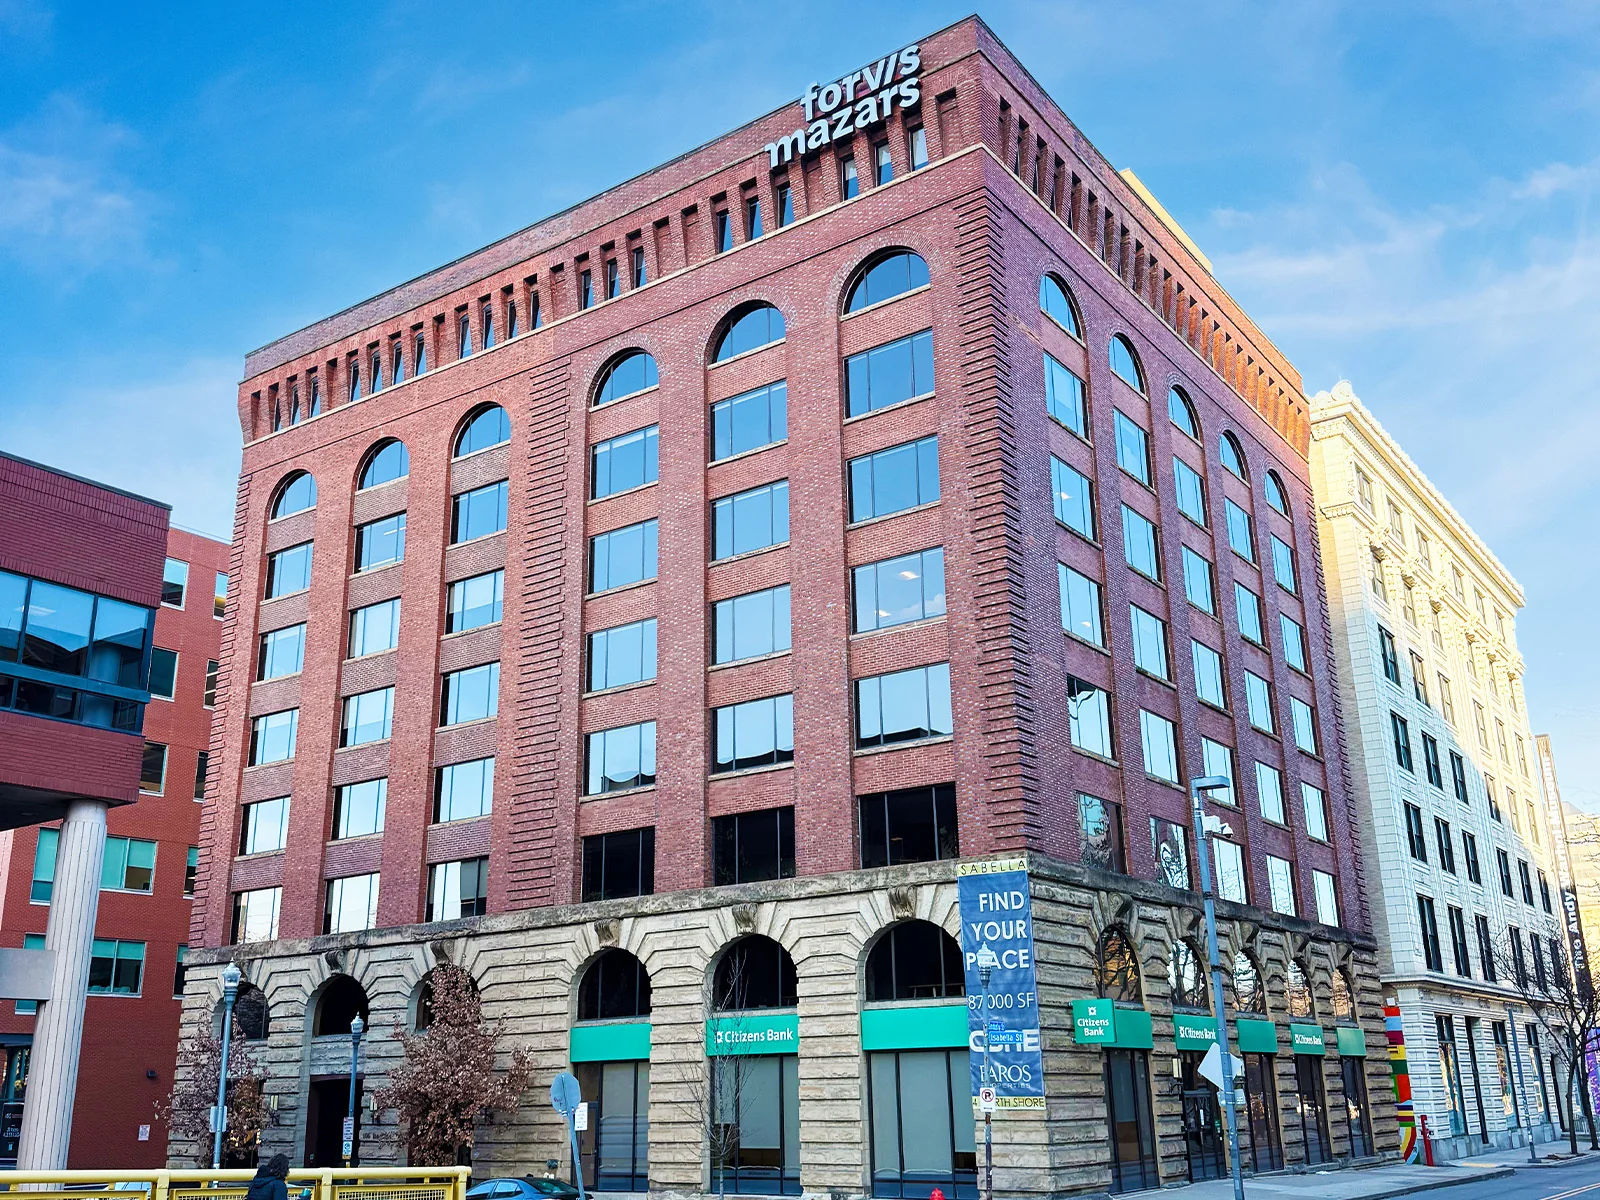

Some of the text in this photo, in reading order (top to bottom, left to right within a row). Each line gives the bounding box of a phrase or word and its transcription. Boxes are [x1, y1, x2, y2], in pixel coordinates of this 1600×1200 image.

[764, 77, 920, 168] mazars
[979, 891, 1025, 913] FIND
[1564, 890, 1580, 935] Andy
[971, 920, 1028, 942] YOUR
[965, 949, 1030, 971] PACE
[1017, 992, 1035, 1008] SF
[1077, 1018, 1110, 1027] Citizens
[725, 1028, 793, 1043] Citizens Bank
[990, 1033, 1023, 1042] Isabella St
[1084, 1027, 1105, 1037] Bank
[1184, 1027, 1217, 1040] Citizens Bank
[1012, 1096, 1045, 1108] SHORE
